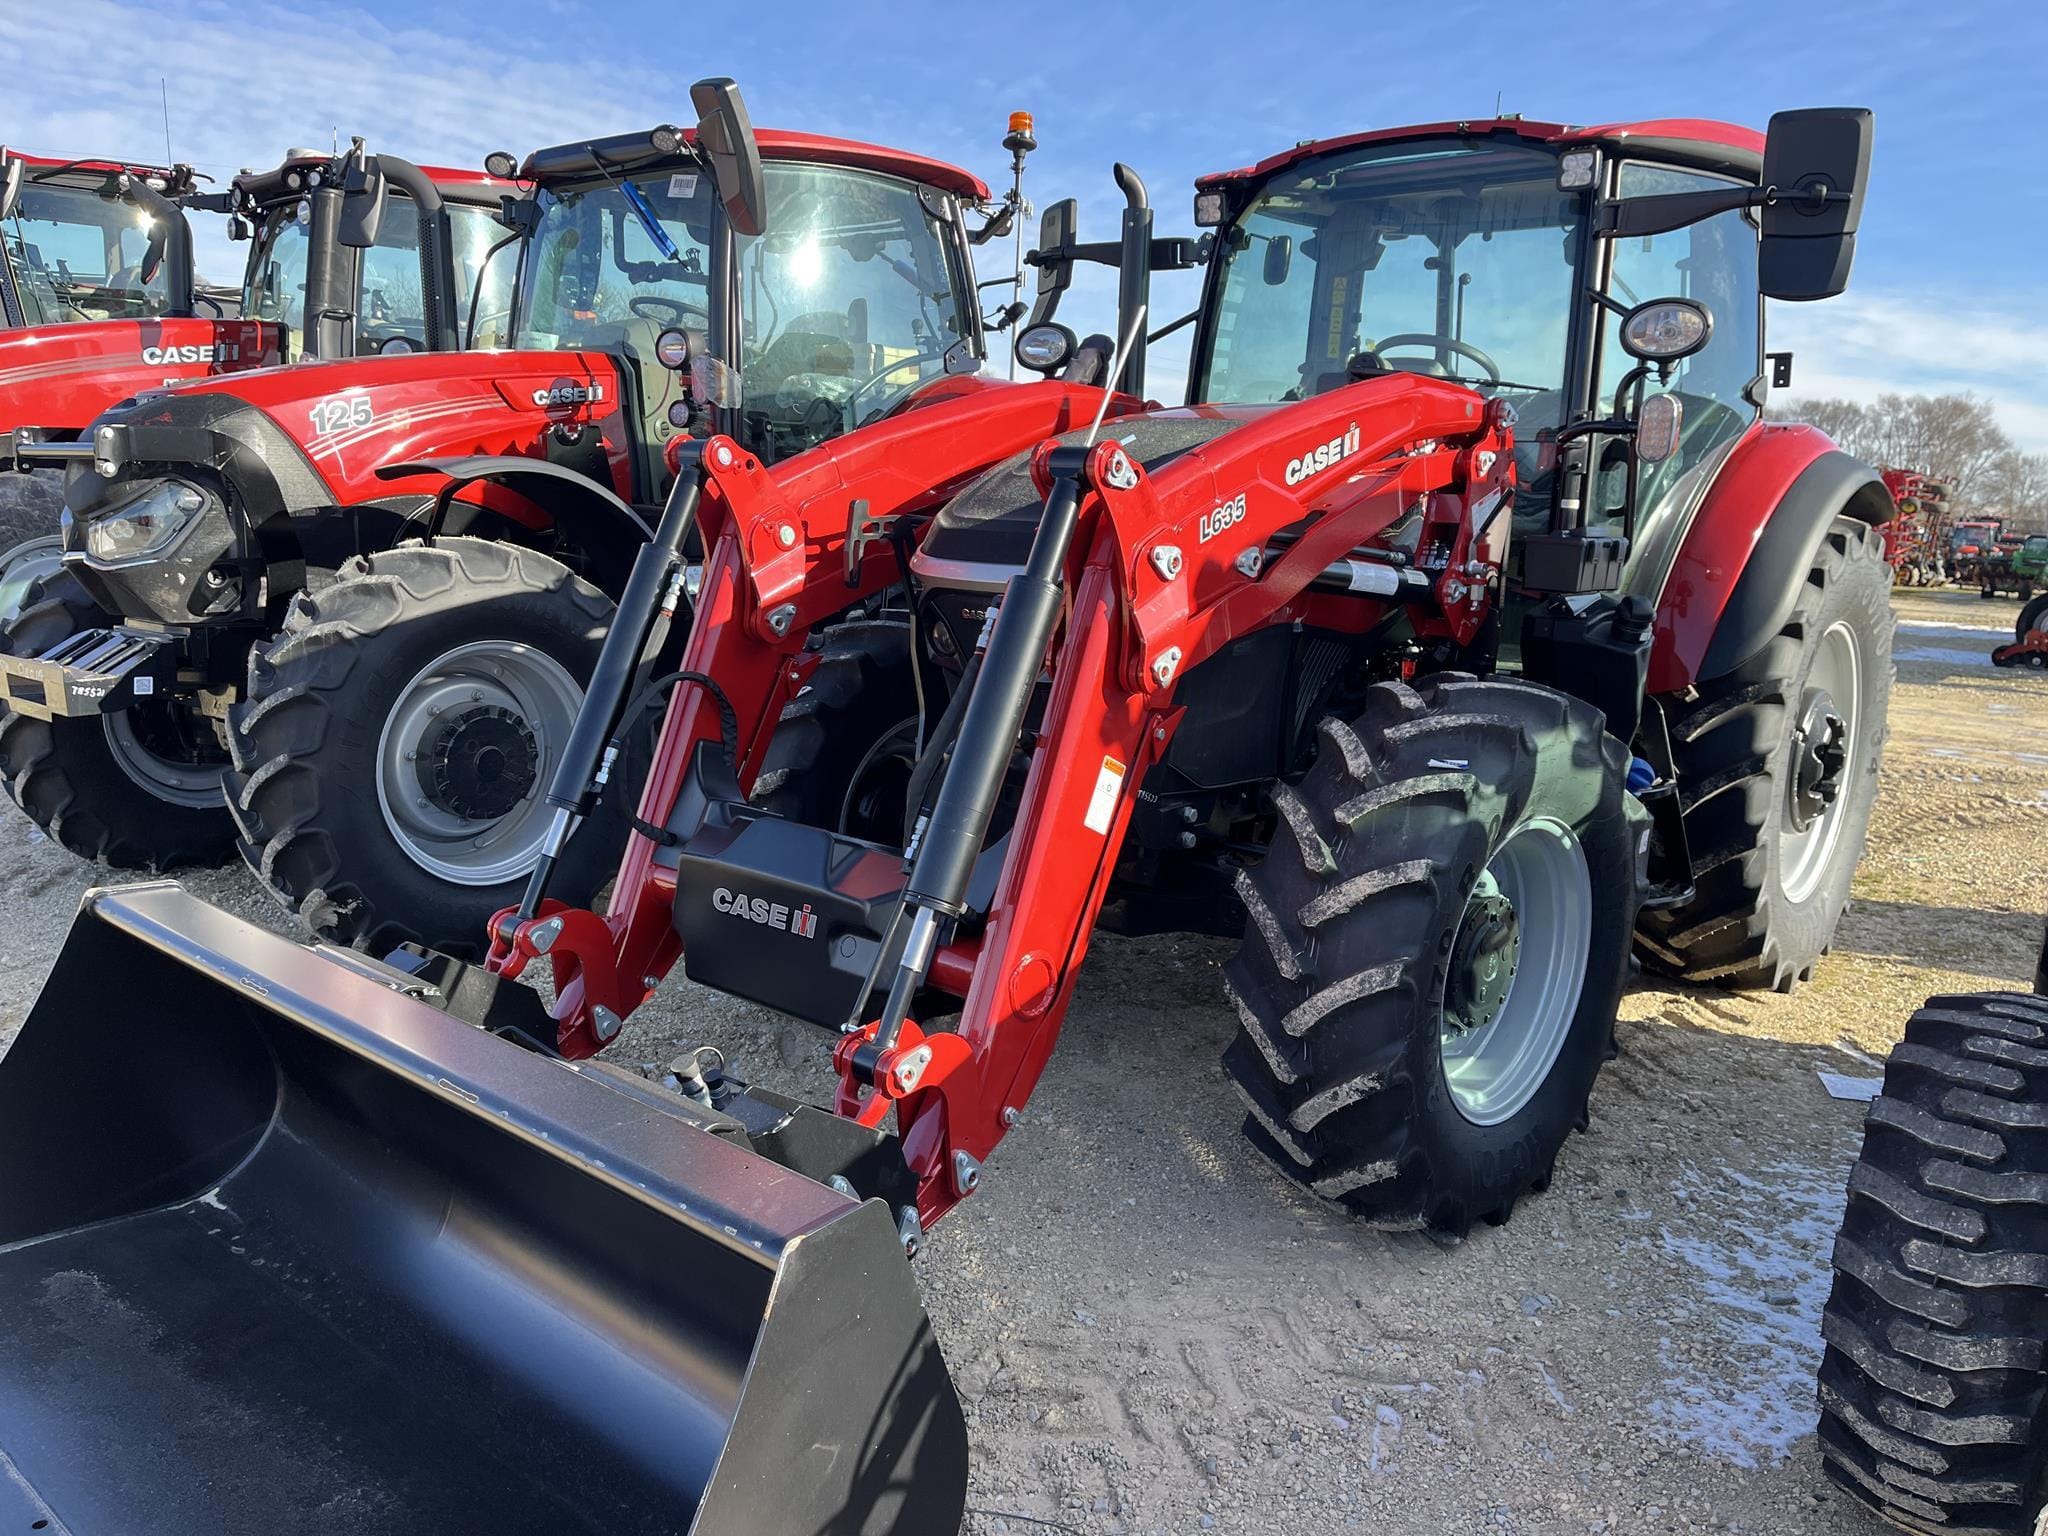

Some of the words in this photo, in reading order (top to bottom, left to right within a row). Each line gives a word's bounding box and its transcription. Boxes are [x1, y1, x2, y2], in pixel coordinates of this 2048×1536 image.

[142, 345, 214, 365] CASE
[309, 396, 374, 435] 125
[532, 387, 587, 406] CASE
[1285, 436, 1343, 486] CASE
[1199, 493, 1247, 545] L635
[961, 608, 985, 620] CAS
[712, 887, 789, 930] CASE
